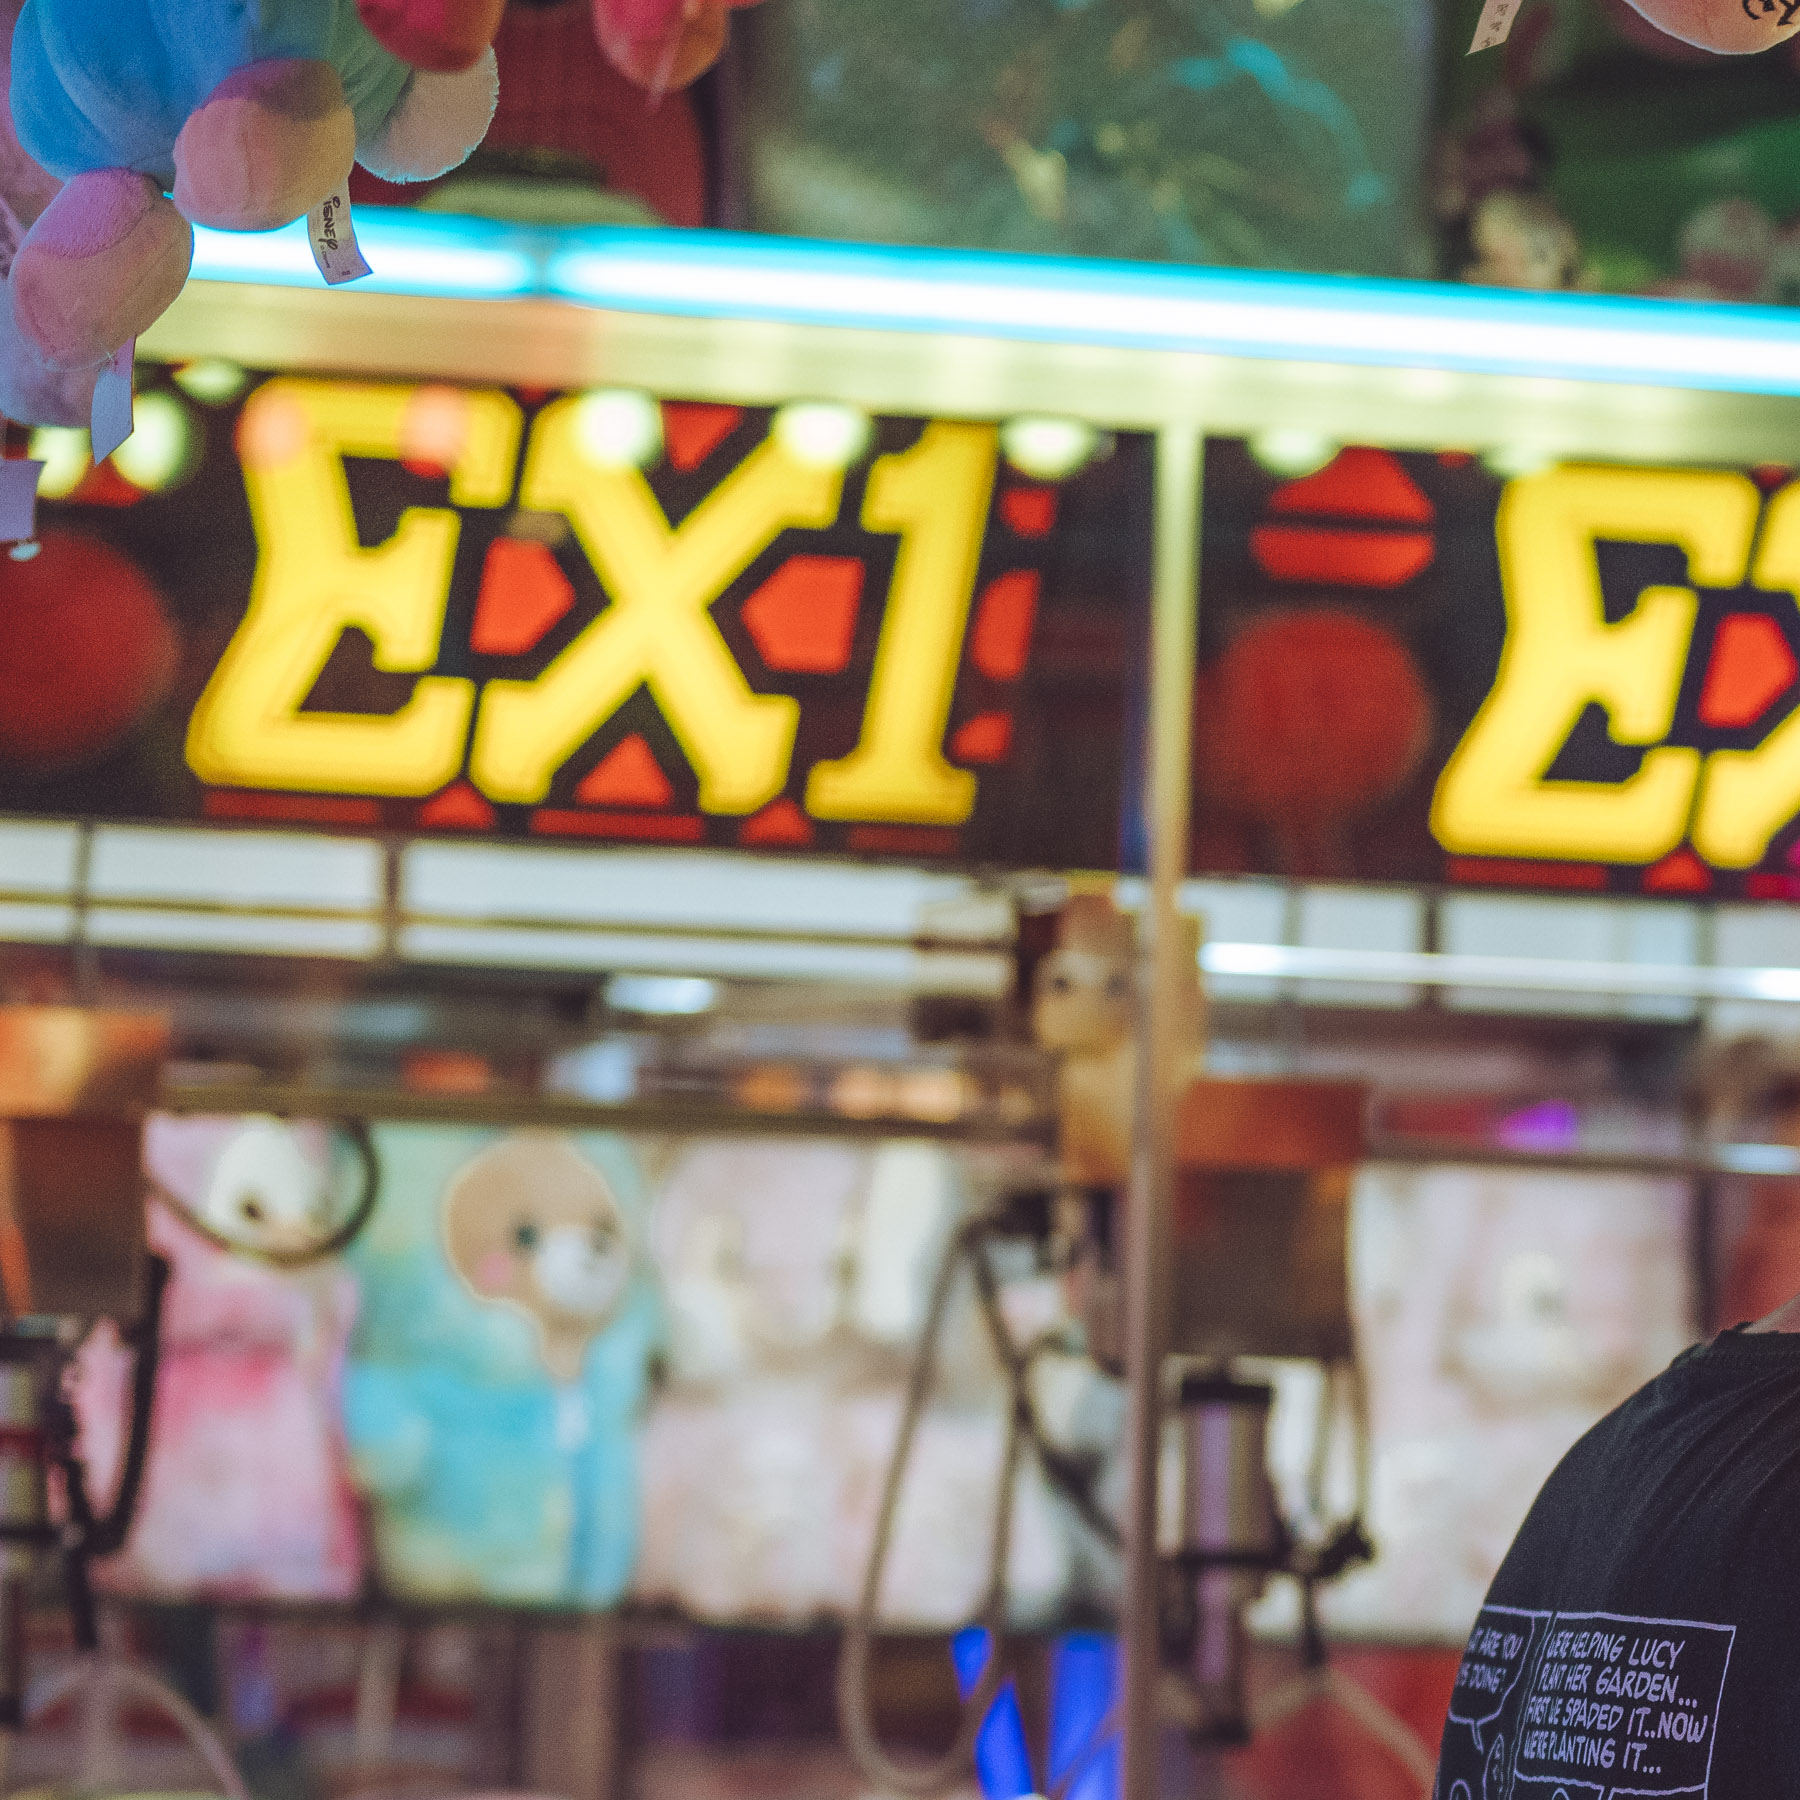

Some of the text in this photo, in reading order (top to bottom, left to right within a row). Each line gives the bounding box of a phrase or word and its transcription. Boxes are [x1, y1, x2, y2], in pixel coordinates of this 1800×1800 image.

[1571, 1631, 1686, 1670] HELPING LUCY
[1537, 1662, 1567, 1693] PLANT
[1564, 1662, 1592, 1694] HER
[1525, 1695, 1551, 1725] FIRST
[1562, 1697, 1624, 1732] SPADED
[1548, 1730, 1617, 1770] PLANTING
